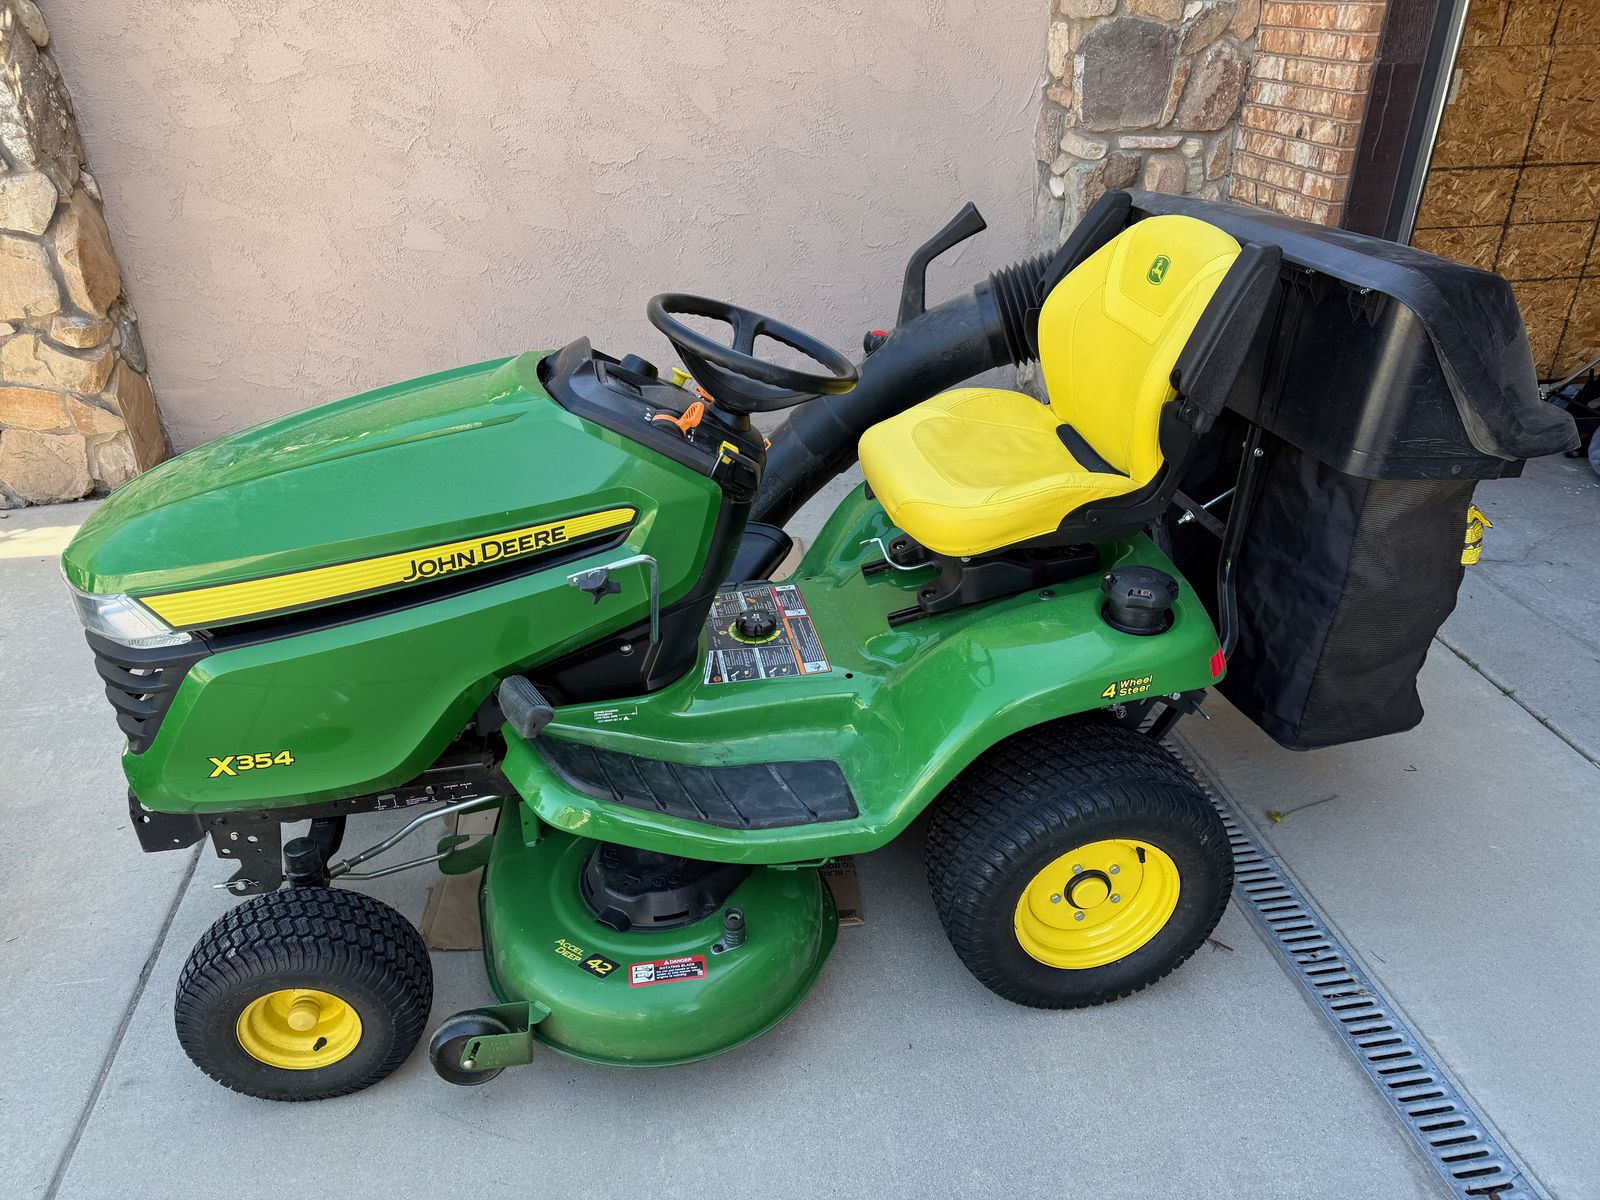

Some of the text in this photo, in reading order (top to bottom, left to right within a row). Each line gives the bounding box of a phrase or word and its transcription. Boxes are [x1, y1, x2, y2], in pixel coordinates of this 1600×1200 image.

[403, 525, 567, 581] JOHN DEERE
[1102, 674, 1153, 698] 4 Wheel
[1119, 684, 1151, 696] Steer
[207, 750, 295, 778] X354
[554, 938, 584, 956] ACCEL
[554, 946, 582, 961] DEEP
[586, 959, 613, 975] 42
[669, 957, 693, 965] DANGER
